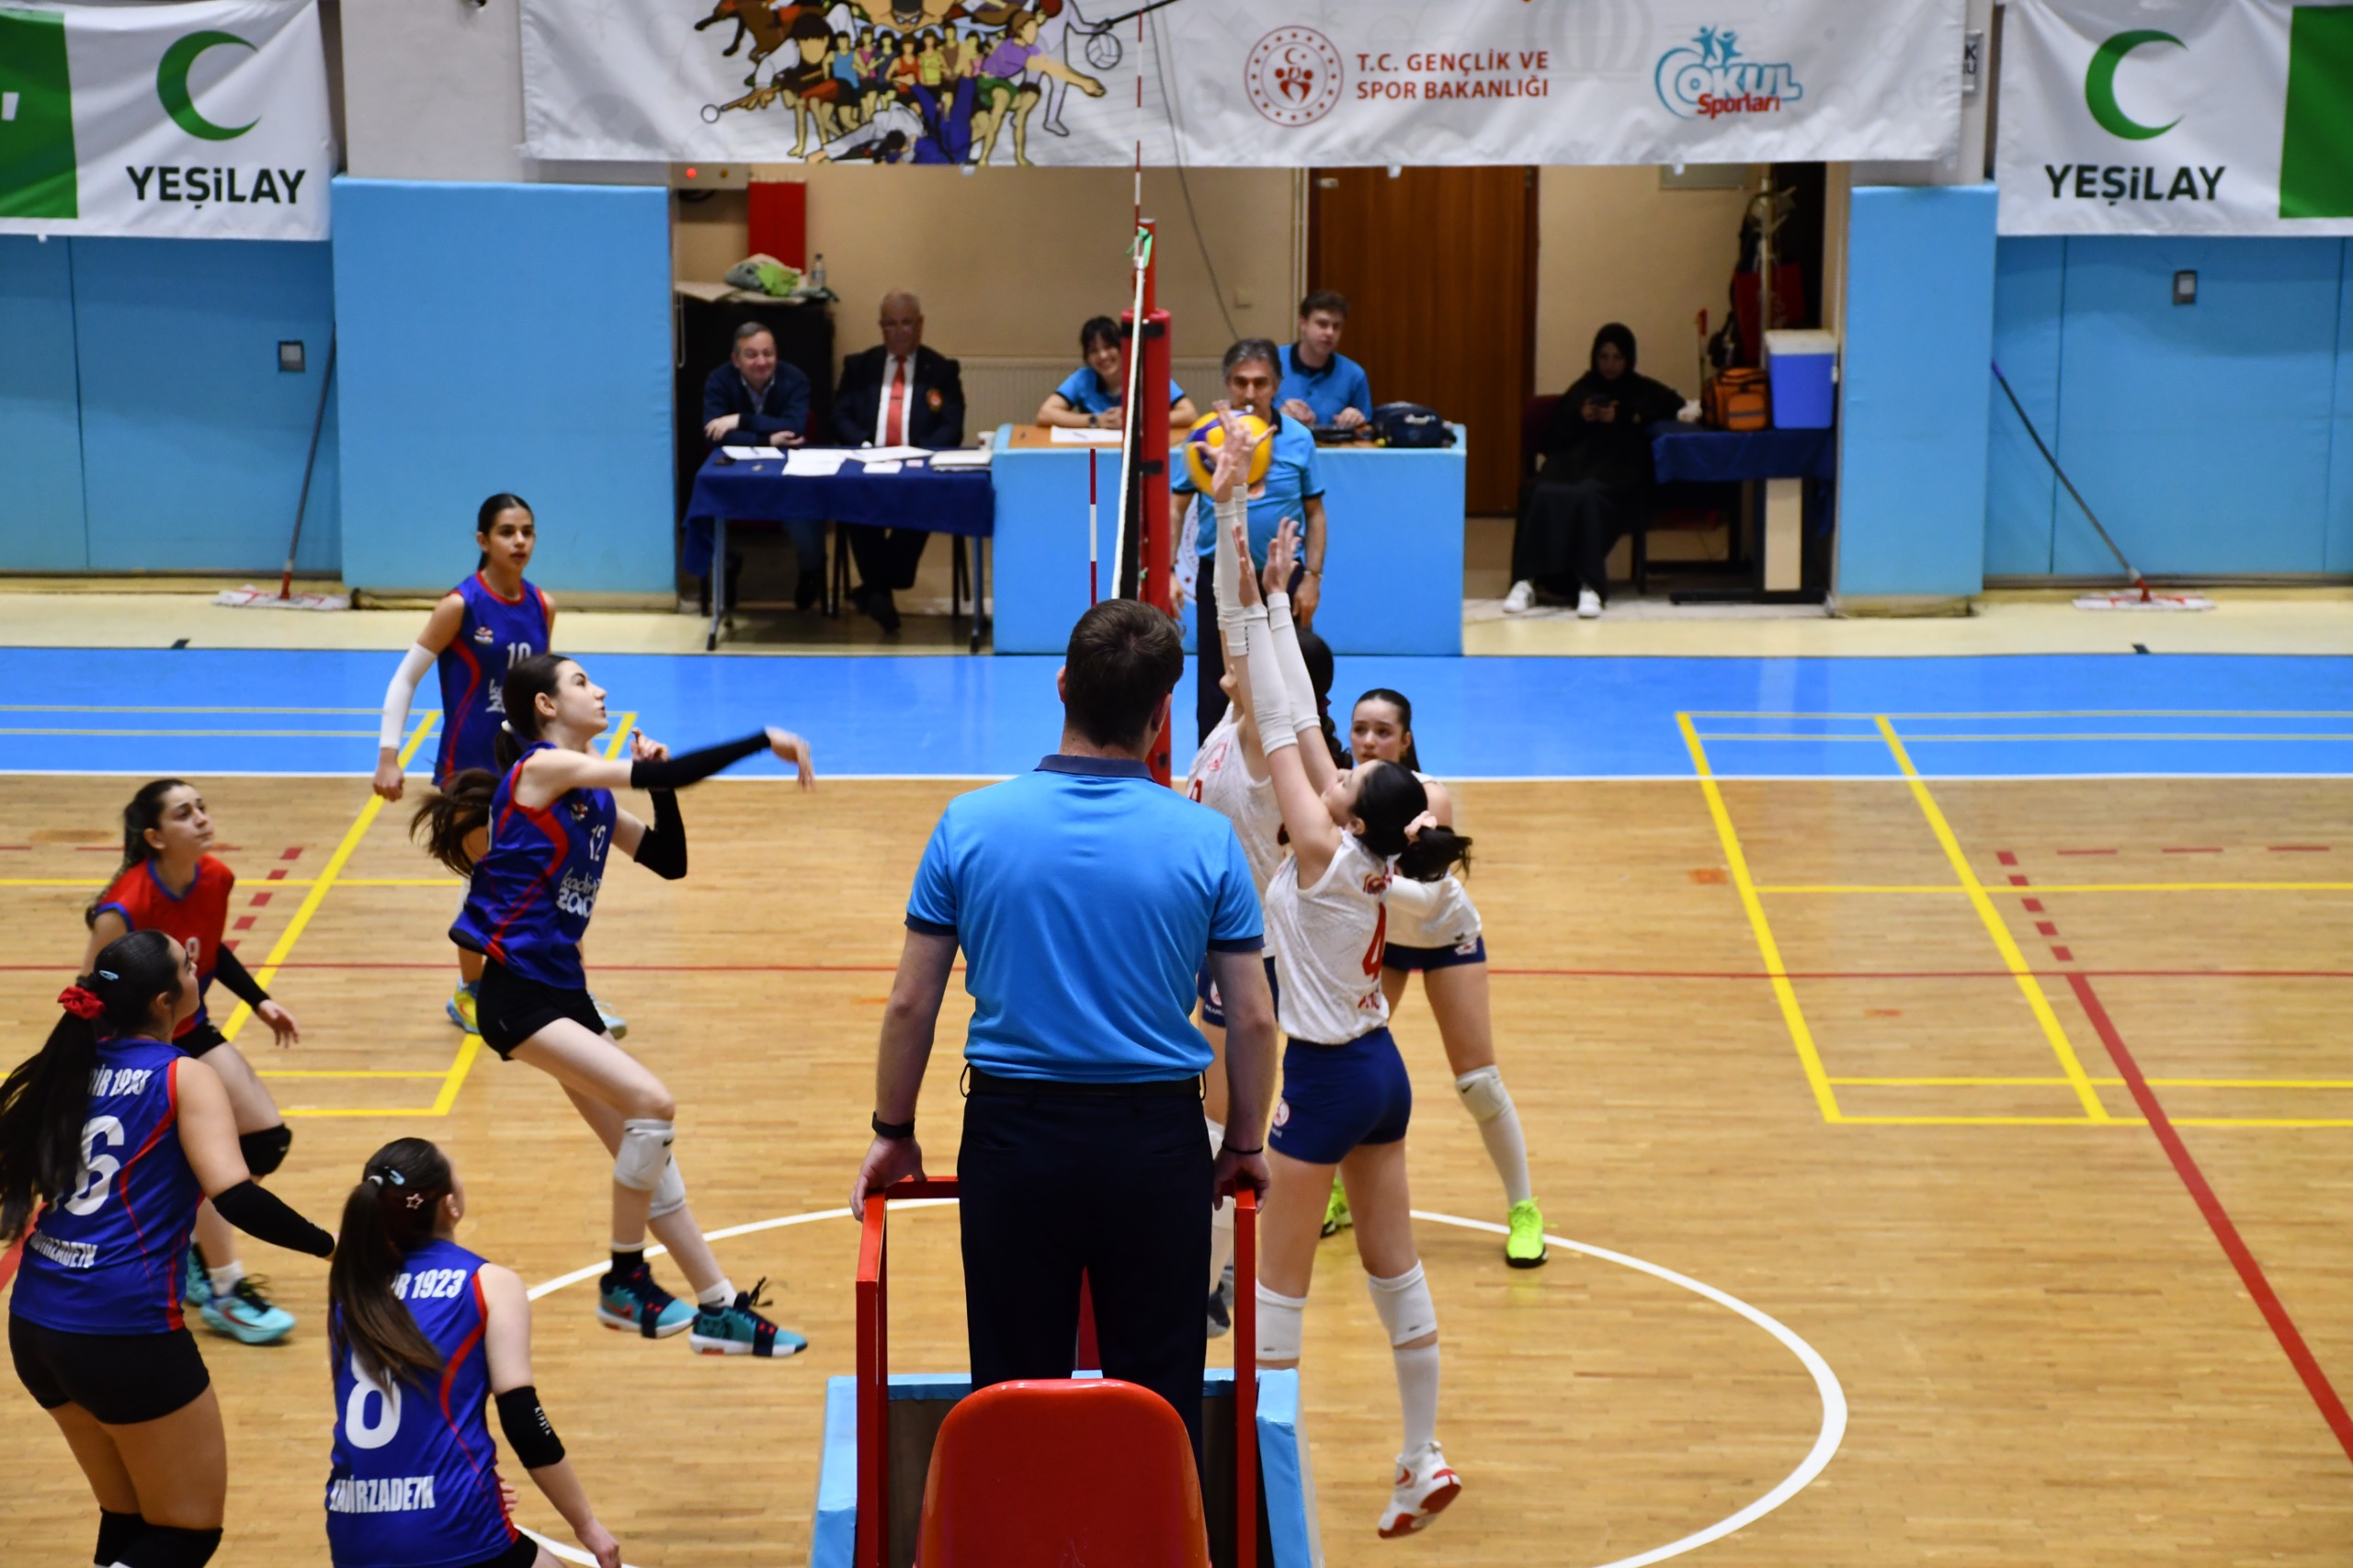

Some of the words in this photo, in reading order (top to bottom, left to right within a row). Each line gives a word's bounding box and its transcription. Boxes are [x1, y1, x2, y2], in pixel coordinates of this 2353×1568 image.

[1357, 53, 1399, 72] T.C.
[1407, 49, 1511, 76] GENÇLİK
[1519, 51, 1549, 70] VE
[1357, 81, 1416, 99] SPOR
[1425, 74, 1549, 99] BAKANLIĞI
[1362, 902, 1387, 983] 4
[64, 1115, 125, 1216] 6
[411, 1268, 467, 1299] 1923
[345, 1351, 402, 1449] 8
